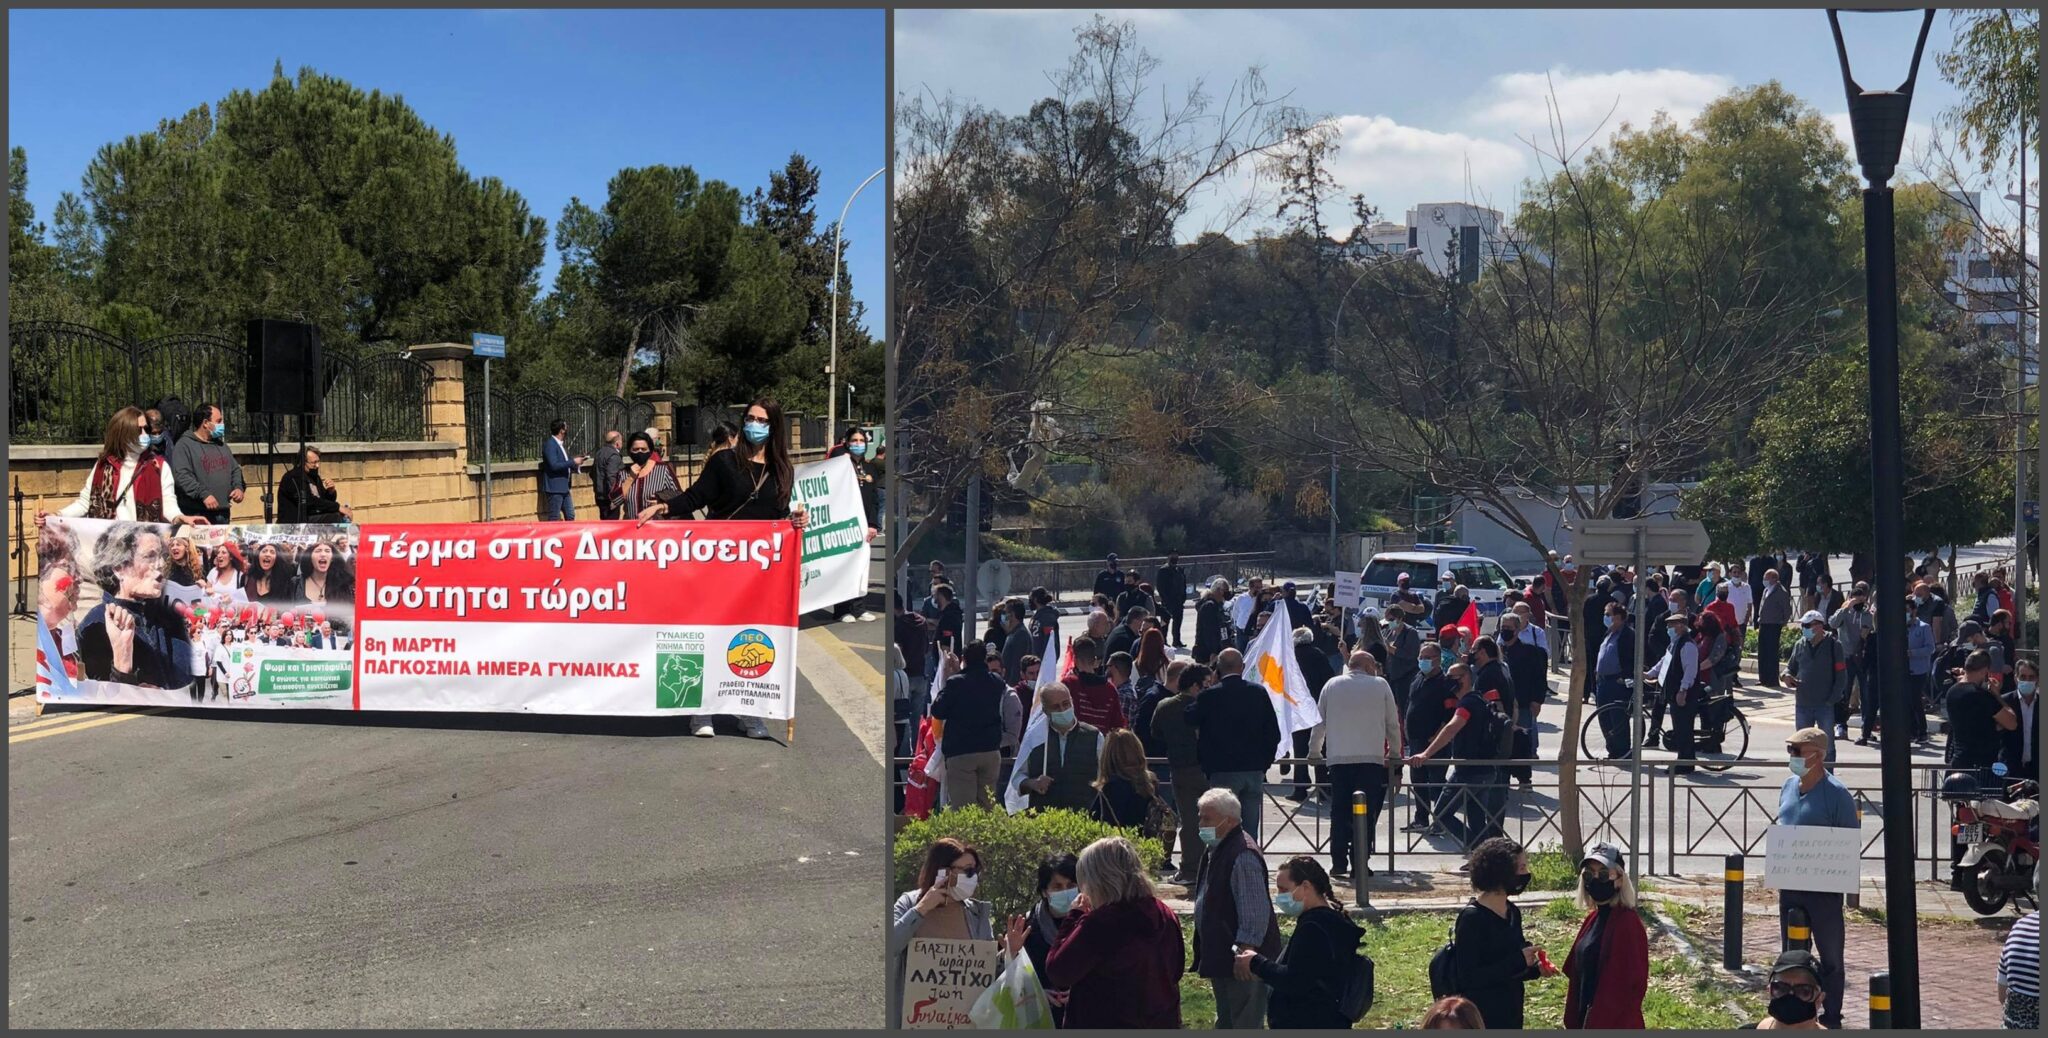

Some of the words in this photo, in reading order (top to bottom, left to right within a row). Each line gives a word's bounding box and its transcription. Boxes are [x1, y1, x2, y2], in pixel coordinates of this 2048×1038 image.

[798, 471, 829, 502] γενιά
[805, 536, 820, 555] και
[821, 523, 862, 550] ισοτιμία
[368, 533, 476, 567] Τέρμα
[488, 537, 564, 568] στις
[574, 531, 784, 570] Διακρίσεις!
[366, 577, 509, 617] Ισότητα
[520, 579, 628, 618] τώρα!
[740, 633, 764, 641] ΠΕΟ
[364, 637, 386, 656] 8η
[392, 638, 457, 653] ΜΑΡΤΗ
[264, 662, 285, 673] Ψωμί
[287, 664, 300, 672] και
[364, 660, 471, 676] ΠΑΓΚΟΣΜΙΑ
[477, 661, 543, 677] ΗΜΕΡΑ
[548, 662, 641, 678] ΓΥΝΑΙΚΑΣ
[719, 681, 745, 689] ΓΡΑΦΕΙΟ
[746, 681, 780, 691] ΓΥΝΑΙΚΩΝ
[740, 697, 755, 705] ΠΕΟ
[914, 941, 975, 959] ΕΛΑΣΤΙΚΑ
[910, 968, 992, 988] ΛΑΣΤΙΧΟ
